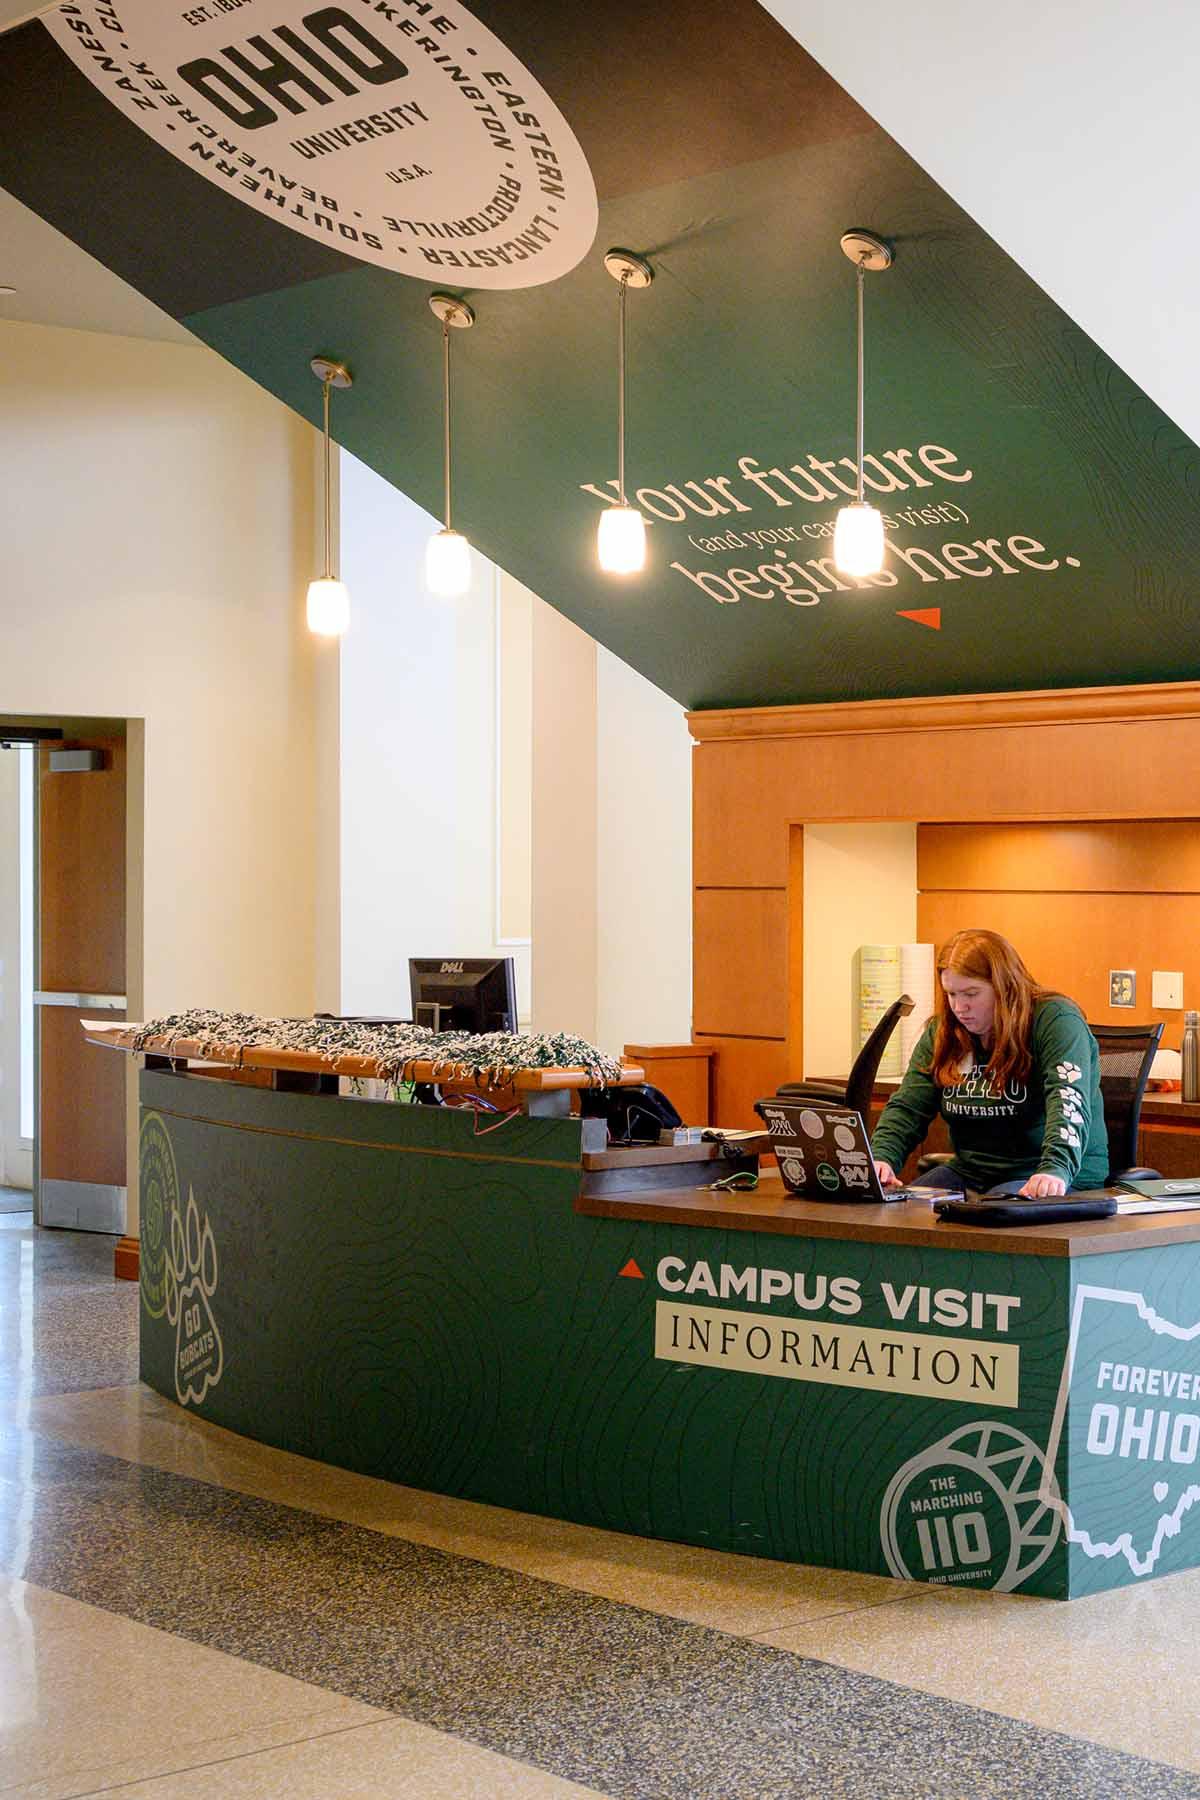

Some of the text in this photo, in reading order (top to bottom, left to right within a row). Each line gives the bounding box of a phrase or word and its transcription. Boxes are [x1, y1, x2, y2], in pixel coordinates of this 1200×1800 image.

[181, 0, 253, 26] EST. 180
[176, 7, 409, 130] OHIO
[362, 0, 516, 151] KERINGTON
[127, 60, 339, 212] BEAVERCREEK
[289, 101, 429, 160] UNIVERSITY
[481, 71, 566, 200] EASTERN
[188, 141, 384, 250] SOUTHERN
[385, 163, 432, 184] U.S.A.
[382, 173, 522, 238] PROCTORVILLE
[418, 214, 559, 267] LANCASTER
[738, 444, 974, 507] future
[687, 501, 969, 555] (and your cas visit)
[884, 535, 1081, 583] here.
[440, 961, 464, 974] DELL
[946, 1101, 1015, 1117] UNIVERSITY
[185, 1303, 201, 1338] GO
[656, 1256, 1021, 1333] CAMPUS VISIT
[180, 1330, 215, 1370] BOBCATS
[671, 1314, 1000, 1392] INFORMATION
[1086, 1402, 1200, 1465] OHIO
[910, 1490, 984, 1513] MARCHING
[929, 1475, 957, 1492] THE
[916, 1511, 992, 1570] 110
